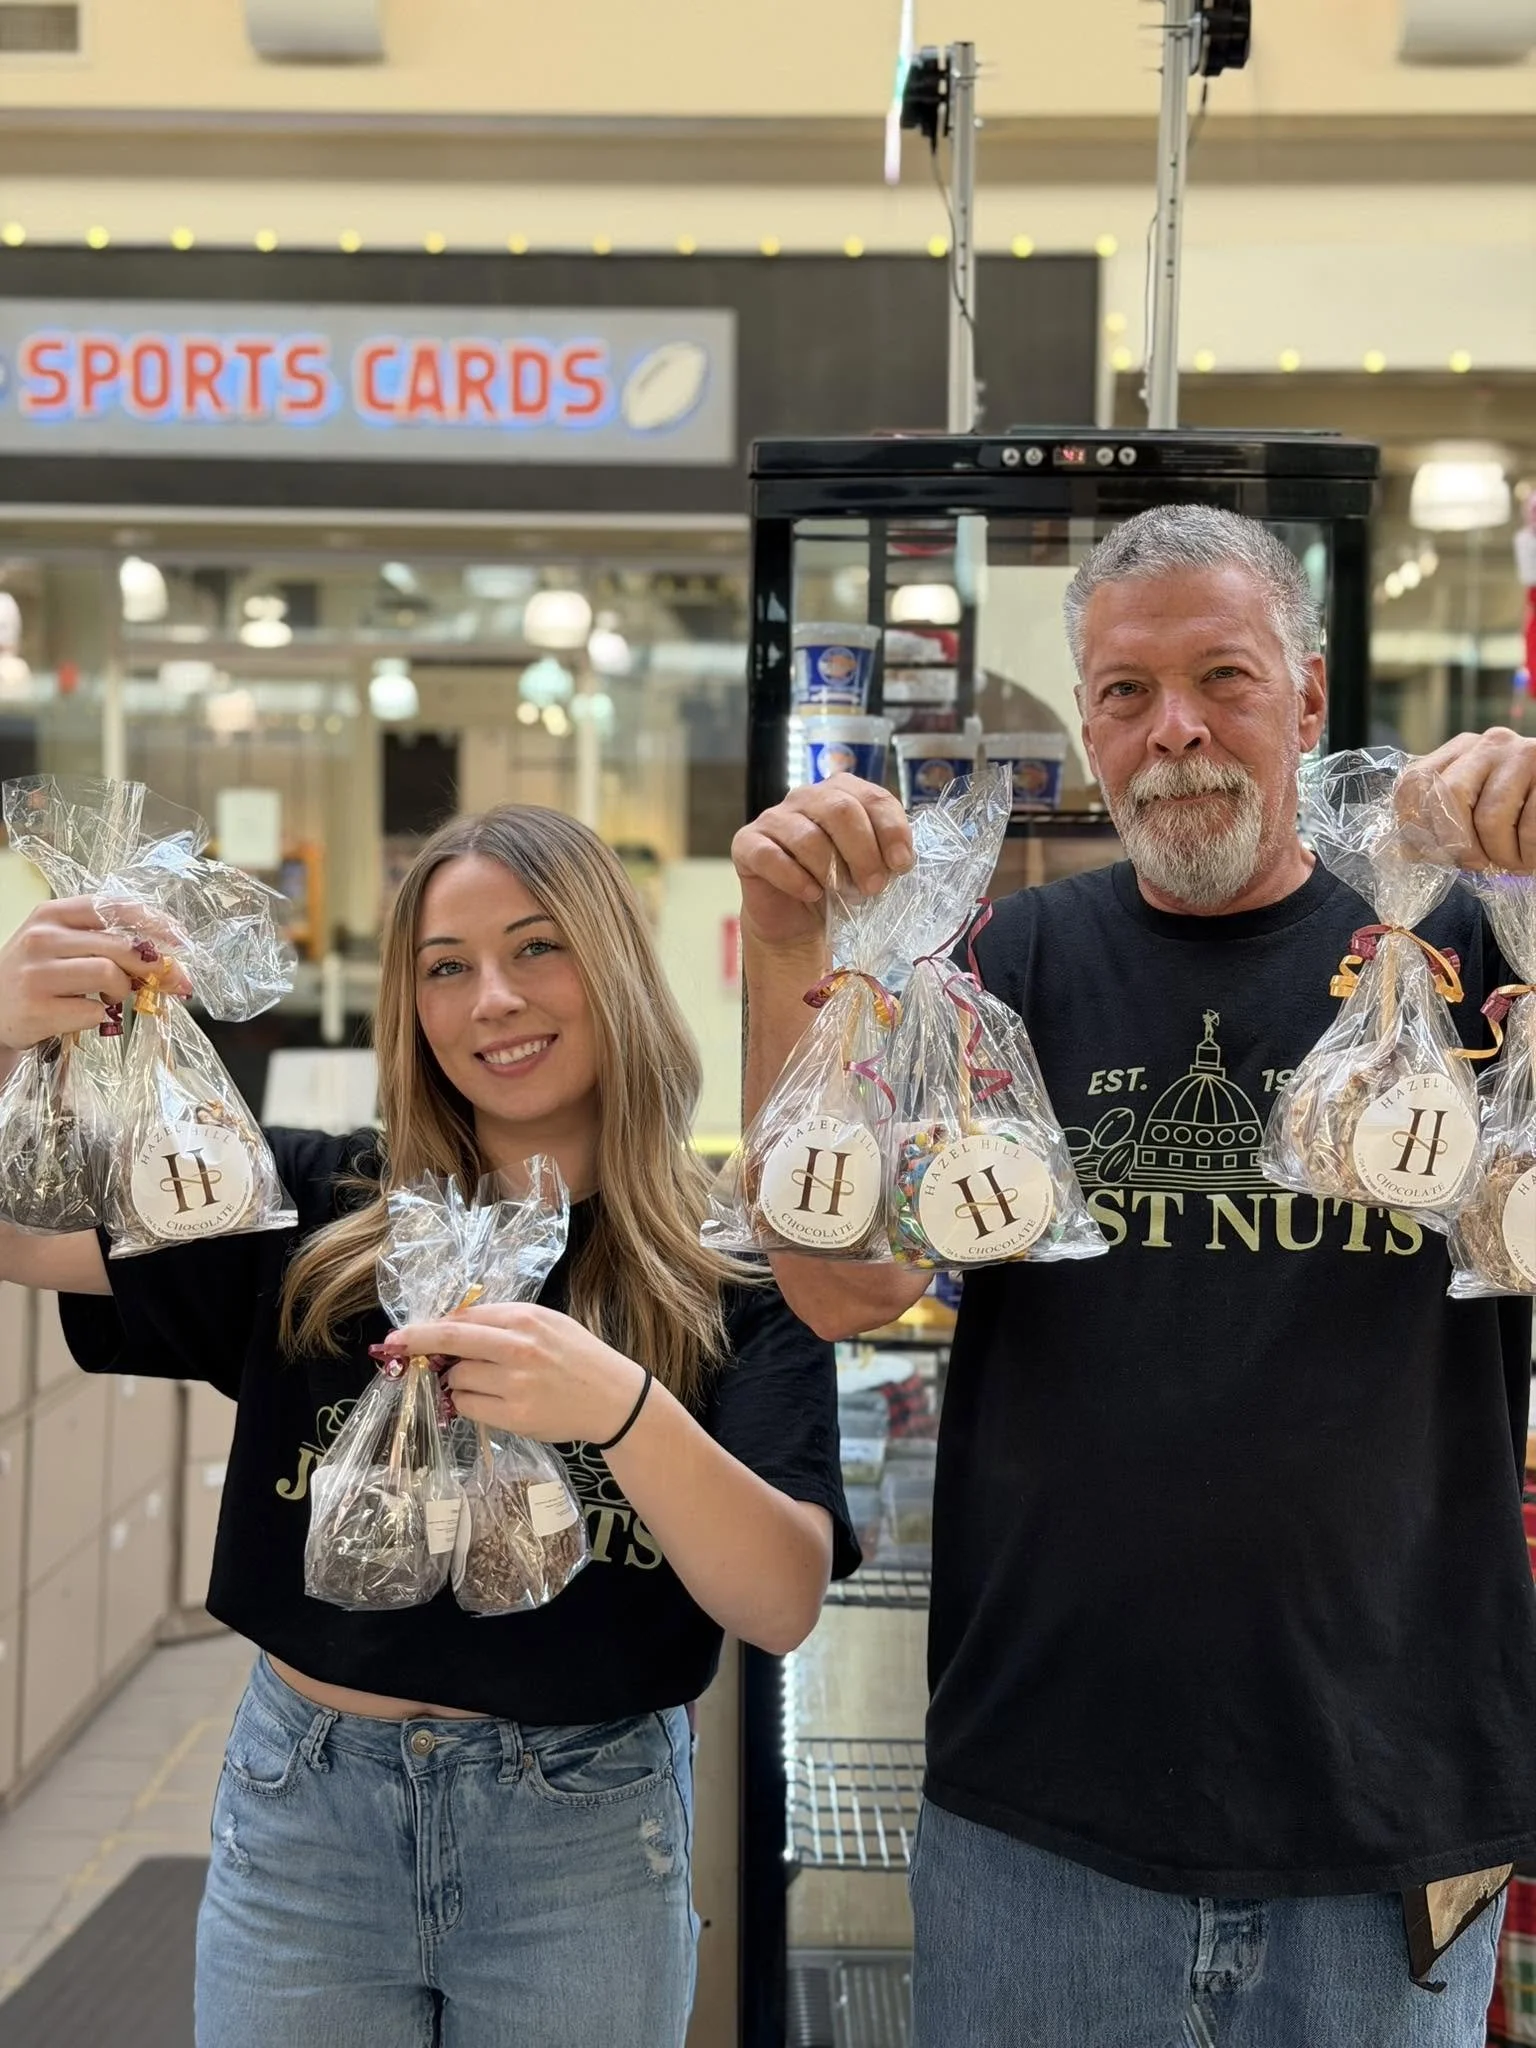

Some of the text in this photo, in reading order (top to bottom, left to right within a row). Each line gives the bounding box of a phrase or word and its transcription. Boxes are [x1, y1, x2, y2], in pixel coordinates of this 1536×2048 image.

[24, 337, 608, 418] SPORTS CARDS
[1087, 1067, 1297, 1095] EST. 19
[1380, 1078, 1440, 1109] HAZEL
[783, 1120, 840, 1148] HAZEL
[925, 1140, 1021, 1196] HAZEL HILL
[1376, 1173, 1445, 1197] CHOCOLATE
[166, 1203, 235, 1231] CHOCOLATE
[781, 1212, 855, 1238] CHOCOLATE
[1086, 1189, 1184, 1248] ST
[1205, 1193, 1423, 1256] NUTS
[968, 1219, 1036, 1255] CHOCOLATE
[583, 1503, 663, 1570] TS
